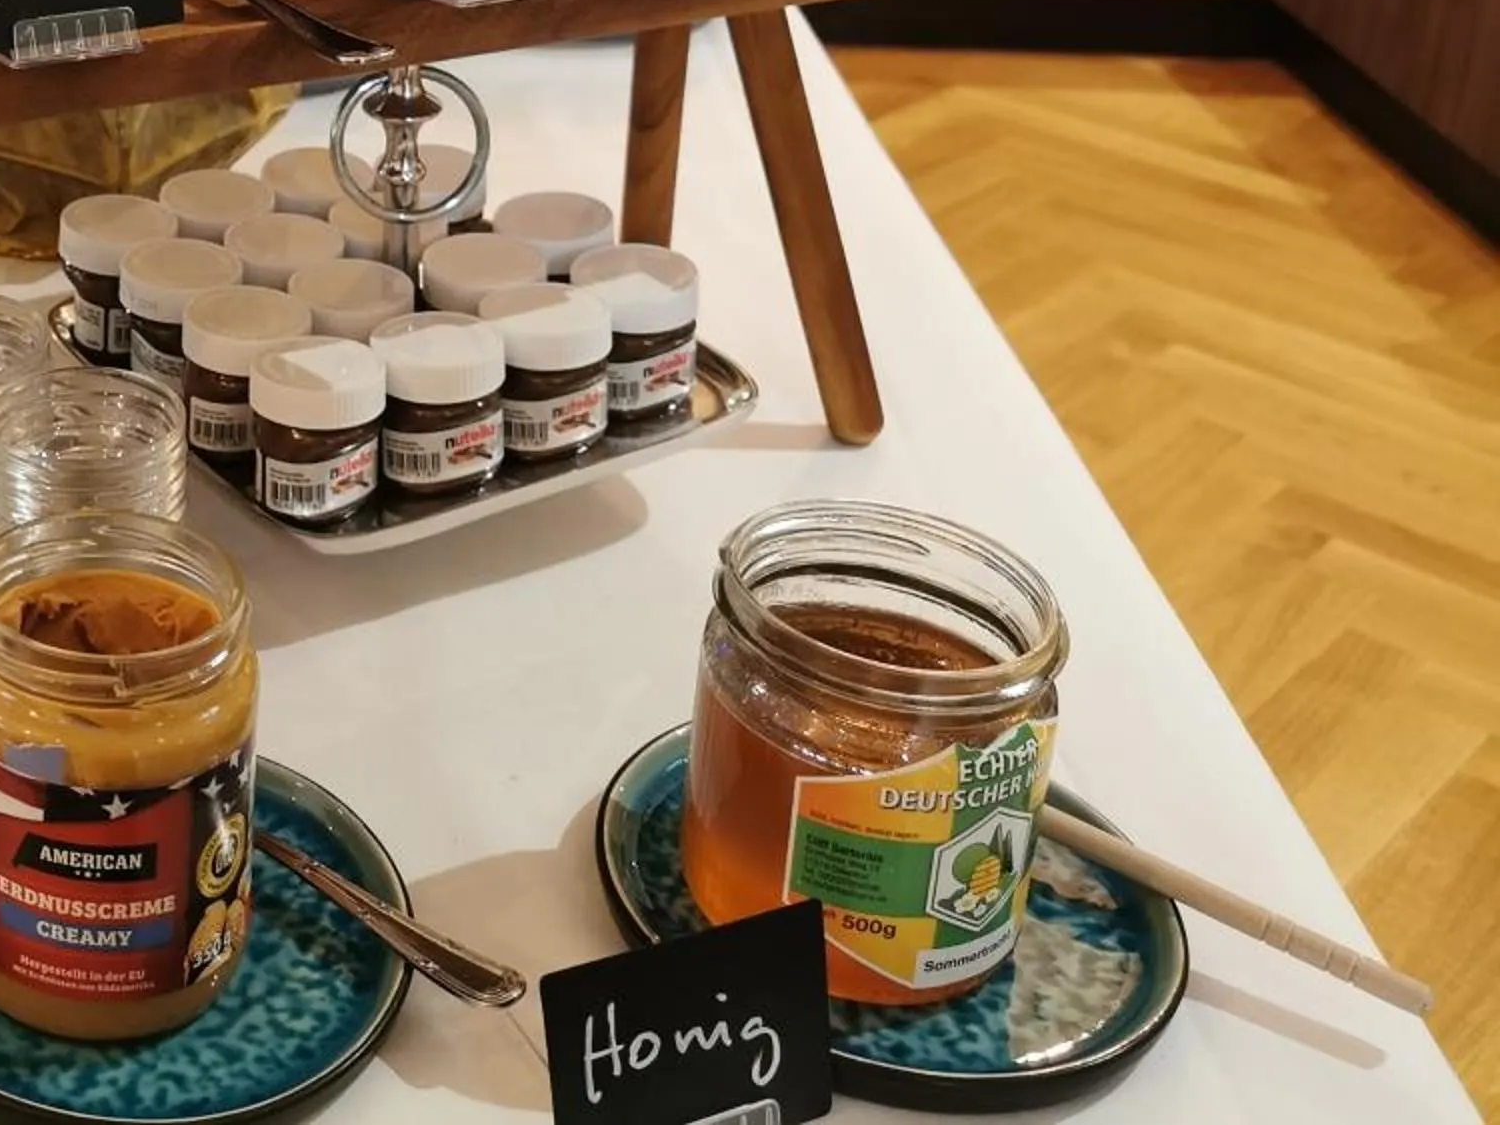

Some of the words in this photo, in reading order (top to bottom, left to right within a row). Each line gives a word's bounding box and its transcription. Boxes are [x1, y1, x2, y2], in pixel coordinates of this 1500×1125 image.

[642, 352, 688, 379] nutella
[552, 391, 601, 419] nutella
[444, 423, 498, 449] nutella
[330, 449, 374, 480] nutella
[958, 739, 1039, 784] ECHTER
[878, 778, 1021, 813] DEUTSCHER
[39, 843, 143, 871] AMERICAN
[0, 875, 177, 921] ERDNUSSCREME
[35, 919, 132, 947] CREAMY
[842, 915, 898, 940] 500g
[20, 954, 87, 980] Hergestellt
[583, 992, 782, 1105] Honig
